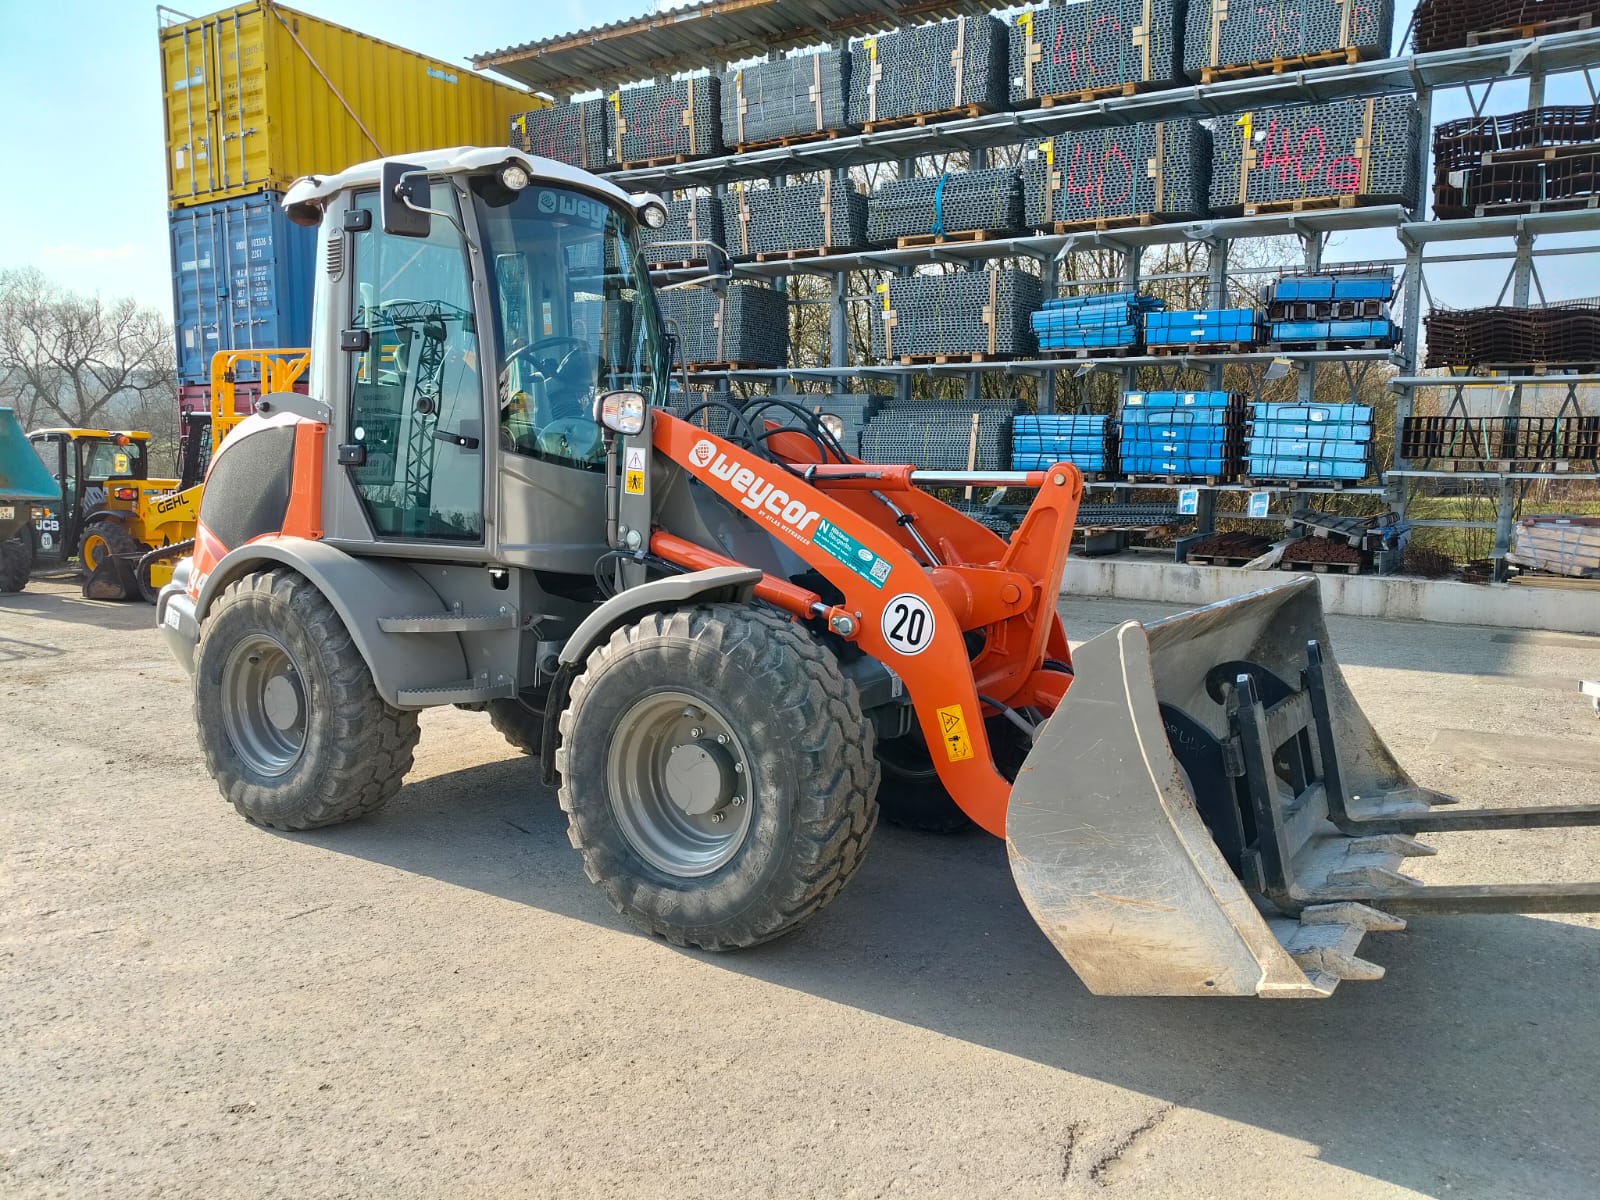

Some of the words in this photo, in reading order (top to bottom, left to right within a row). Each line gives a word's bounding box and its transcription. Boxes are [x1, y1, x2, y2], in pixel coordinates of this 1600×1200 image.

[1263, 120, 1325, 181] 40
[1068, 142, 1132, 208] 40
[559, 195, 626, 233] weycor
[157, 493, 189, 513] GEHL
[708, 453, 820, 531] weycor
[36, 520, 60, 531] JCB
[765, 514, 781, 527] ATLAS
[890, 603, 926, 646] 20
